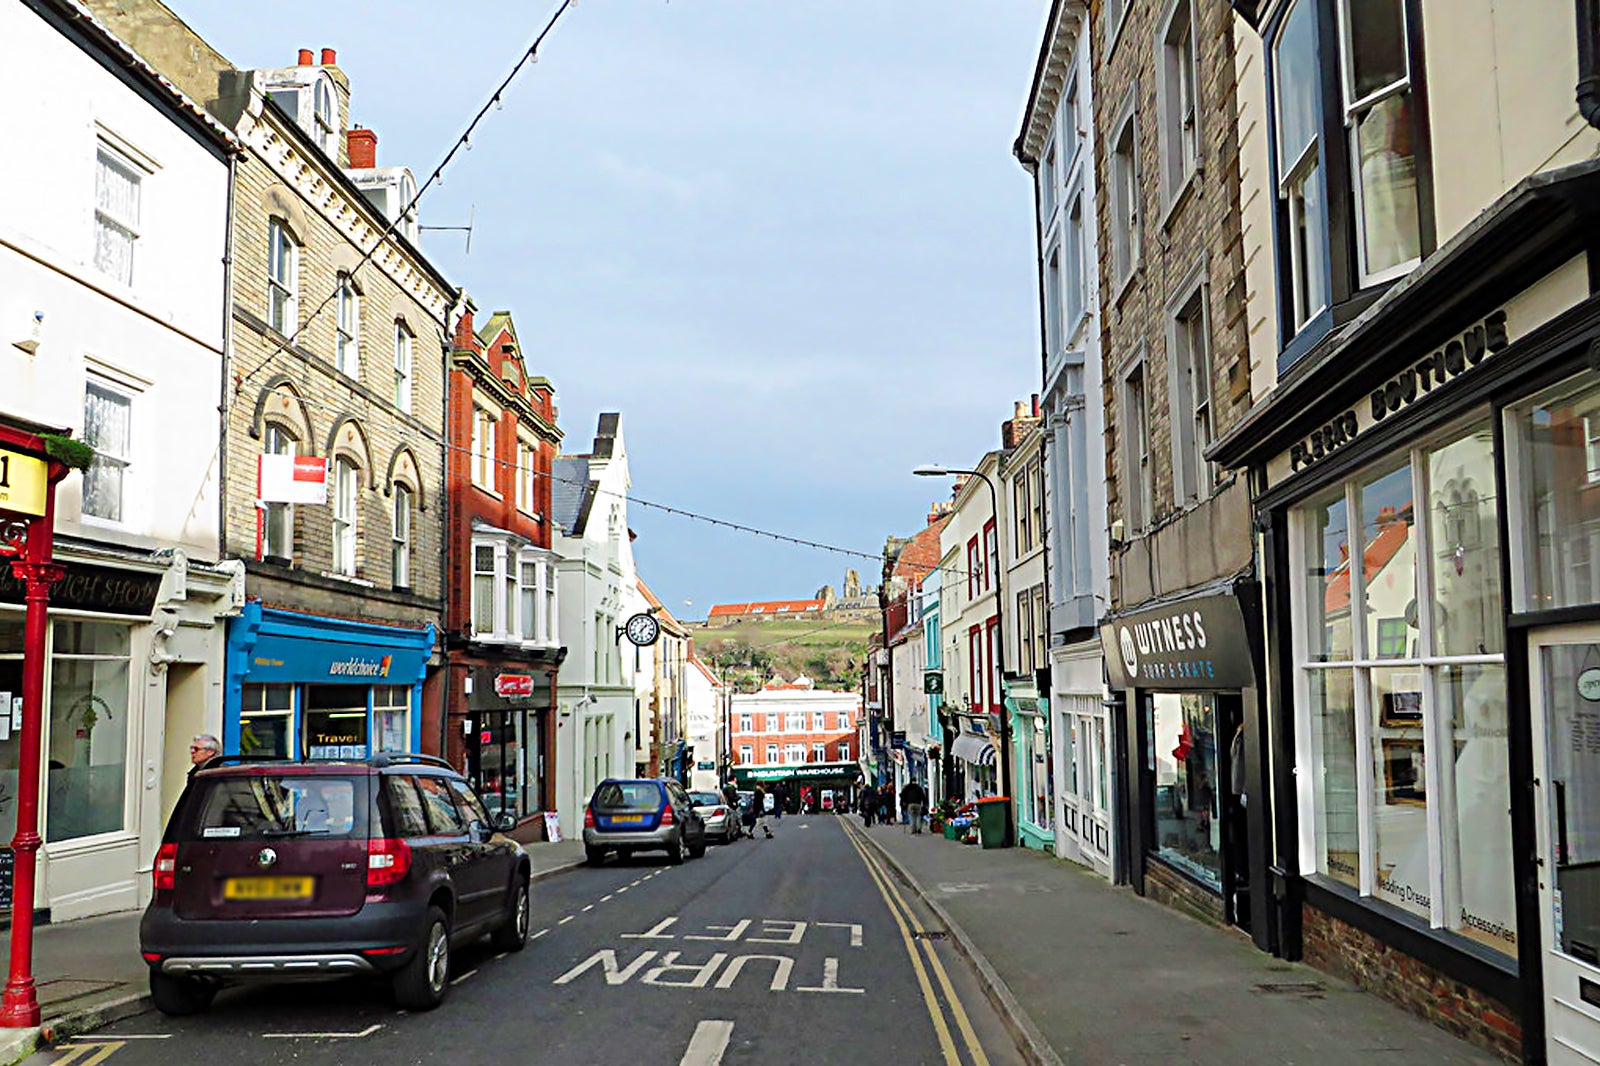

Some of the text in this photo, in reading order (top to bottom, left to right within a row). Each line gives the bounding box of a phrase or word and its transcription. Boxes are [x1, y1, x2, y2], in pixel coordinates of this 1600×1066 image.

[1371, 310, 1508, 420] BOUTIQUE
[1134, 611, 1207, 655] WITNESS
[1142, 663, 1165, 679] SURF
[1177, 660, 1214, 679] SKATE
[620, 916, 863, 947] LEFT
[1461, 907, 1515, 944] Accessories
[552, 949, 866, 994] TURN
